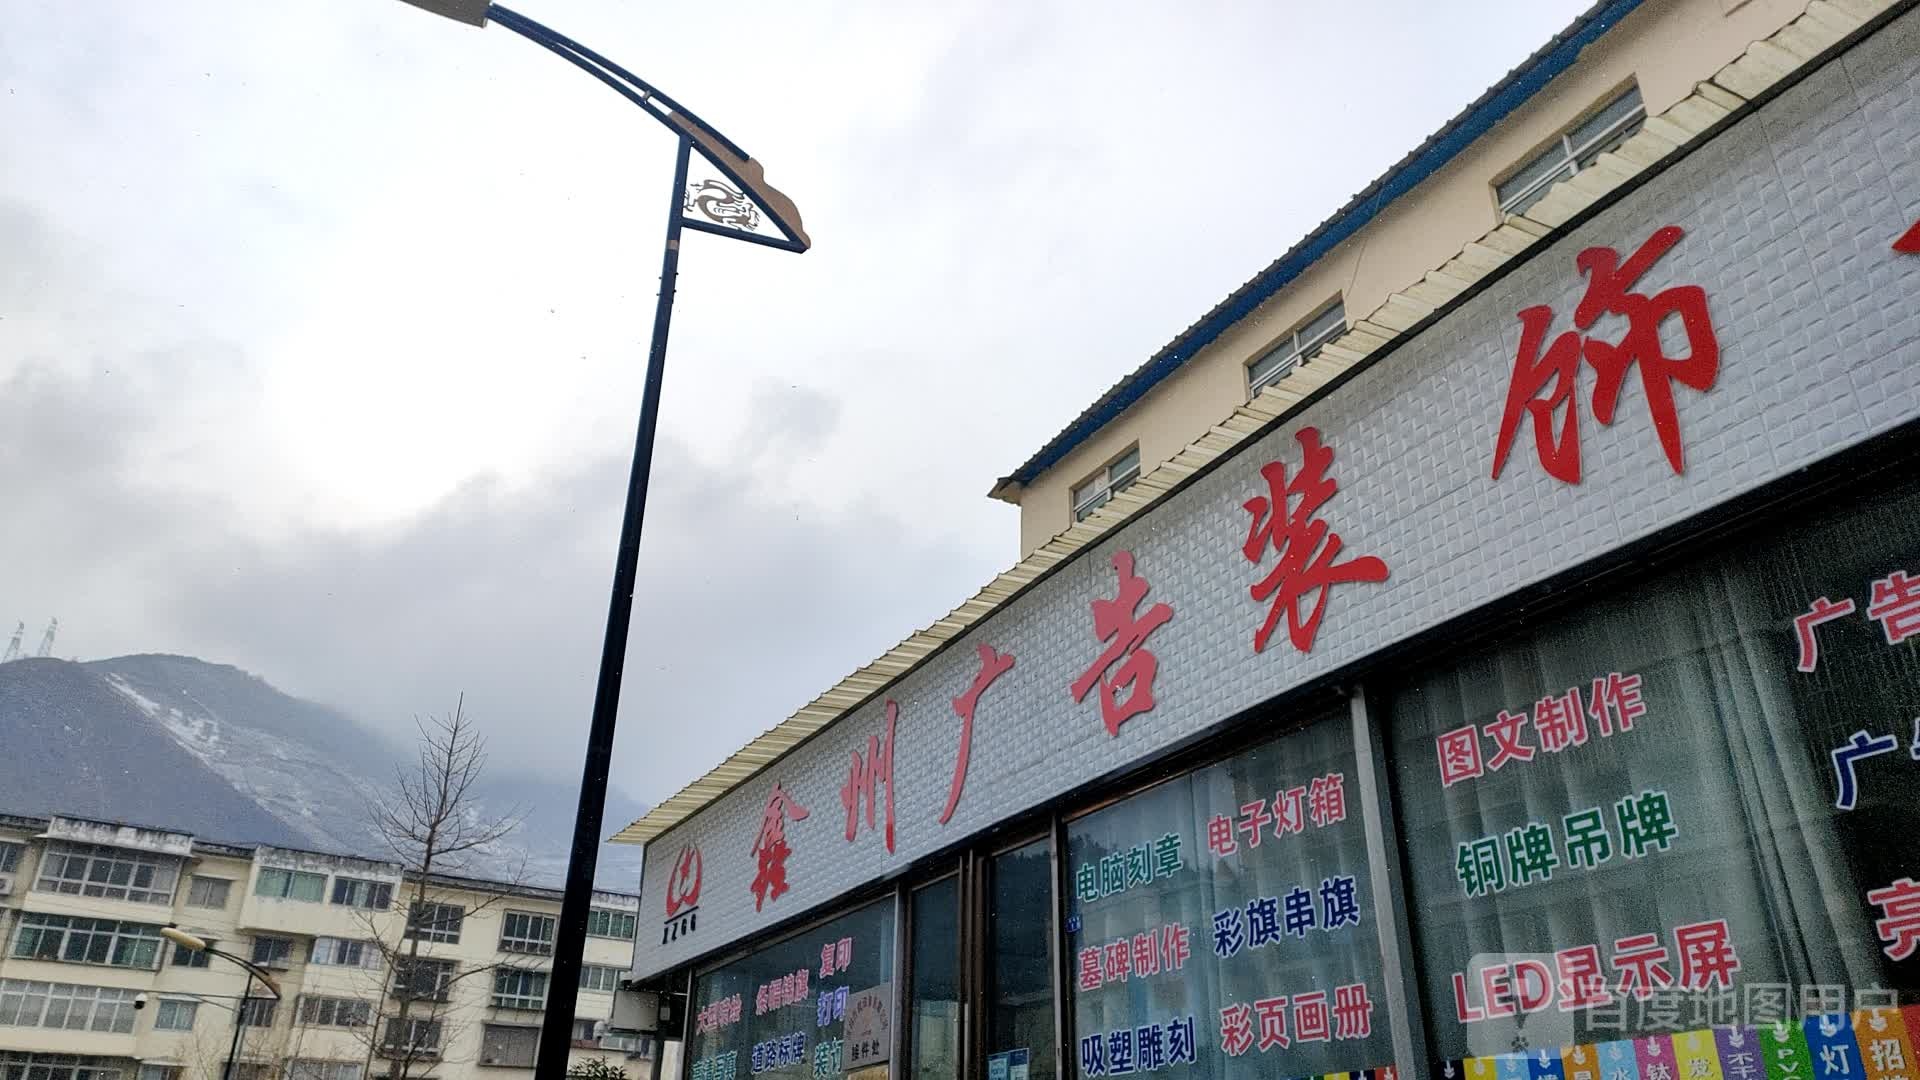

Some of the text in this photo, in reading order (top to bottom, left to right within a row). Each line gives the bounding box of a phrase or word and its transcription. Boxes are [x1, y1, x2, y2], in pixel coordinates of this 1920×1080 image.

[750, 221, 1920, 914] 鑫州广告装饰
[1794, 570, 1920, 672] 广告
[1437, 672, 1647, 787] 图文制作
[1831, 717, 1920, 811] 广
[1208, 773, 1346, 857] 电子灯箱
[1455, 789, 1678, 898] 铜牌吊牌
[1076, 833, 1183, 902] 电脑刻章
[1213, 875, 1361, 957] 彩旗串旗
[819, 937, 852, 979] 复印
[1079, 922, 1190, 992] 墓碑制作
[1452, 919, 1741, 1023] LED显示屏
[816, 986, 849, 1027] 打印
[1220, 983, 1373, 1055] 彩页画册
[751, 1030, 807, 1075] 道路标牌
[813, 1037, 845, 1080] 装订
[1080, 1016, 1196, 1078] 吸塑雕刻
[1819, 1044, 1851, 1075] 灯
[1869, 1038, 1908, 1080] 招
